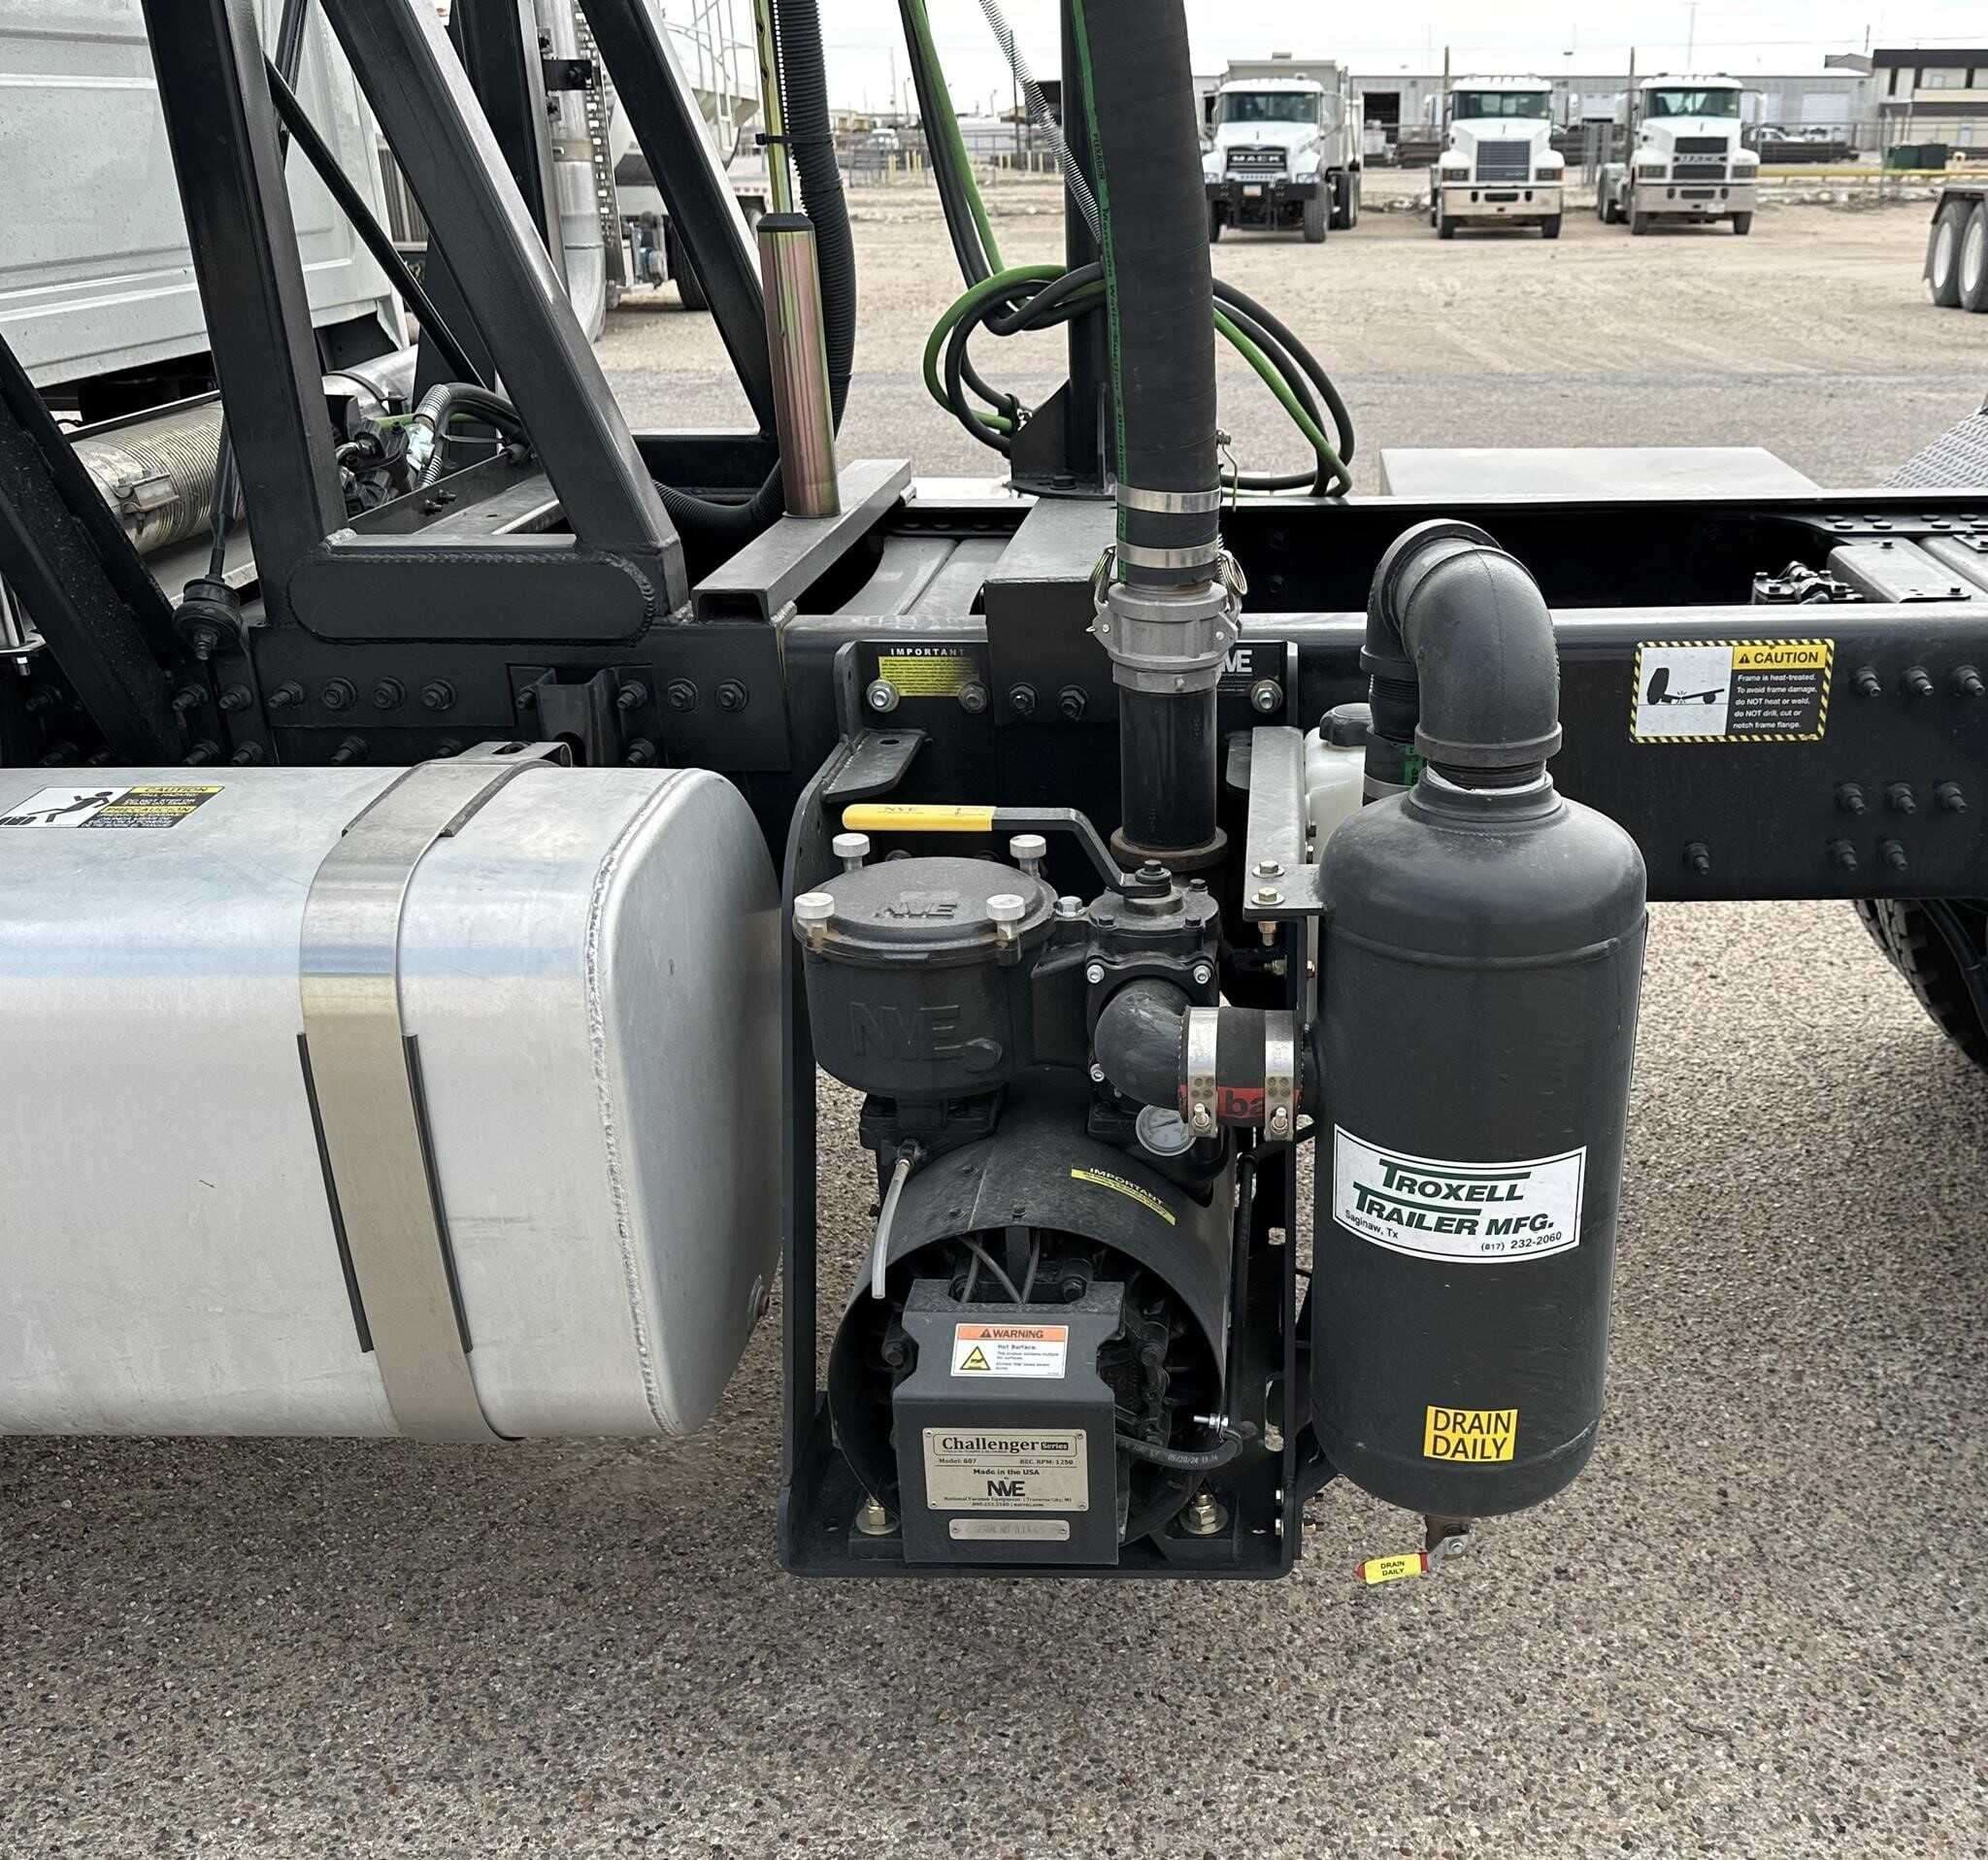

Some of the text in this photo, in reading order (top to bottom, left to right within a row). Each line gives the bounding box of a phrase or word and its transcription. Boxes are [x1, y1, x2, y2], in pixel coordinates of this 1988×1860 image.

[890, 648, 965, 656] IMPORTANT
[1753, 651, 1818, 664] CAUTION
[1089, 1167, 1165, 1206] IMPORTANT
[1378, 1158, 1531, 1203] TROXELL
[1352, 1180, 1554, 1236] TRAILER MFG.
[1345, 1209, 1399, 1239] Saginaw, Tx
[1481, 1231, 1562, 1251] (817) 232-2060
[992, 1329, 1044, 1339] WARNING
[1433, 1409, 1511, 1435] DRAIN
[942, 1437, 1041, 1453] Challenger
[1432, 1434, 1508, 1460] DAILY
[986, 1480, 1026, 1497] NVE
[1380, 1560, 1406, 1570] DRAIN
[1381, 1567, 1405, 1577] DAILY
